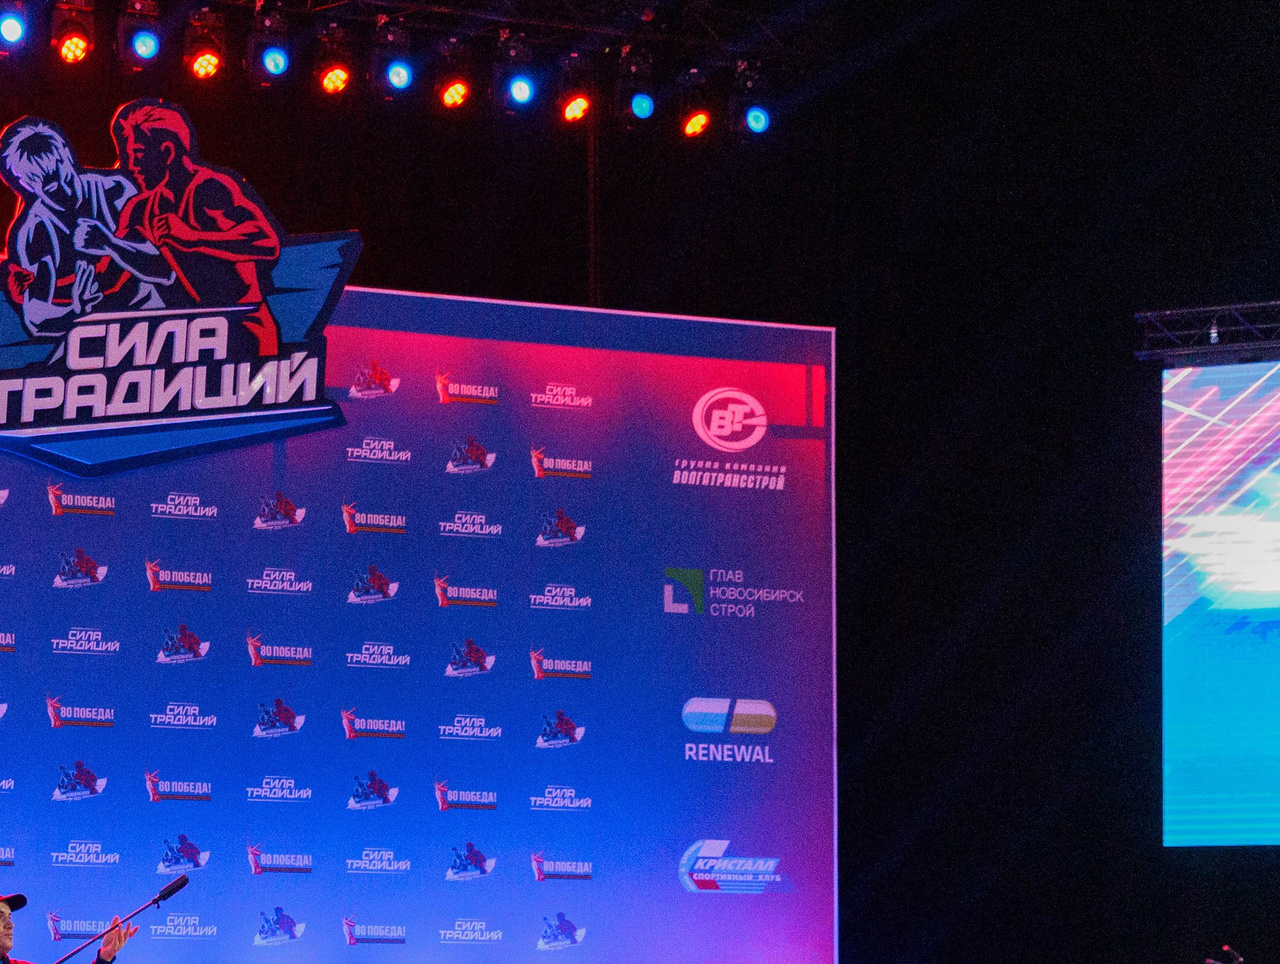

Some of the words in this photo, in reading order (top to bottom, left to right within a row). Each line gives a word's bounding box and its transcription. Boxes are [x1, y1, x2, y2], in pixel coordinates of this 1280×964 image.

[67, 316, 229, 370] СИЛА
[448, 383, 459, 393] 80
[460, 384, 498, 398] ПОБЕДА!
[546, 386, 576, 396] СИЛА
[530, 394, 592, 407] ТРАДИЦИЙ
[362, 440, 394, 450] СИЛА
[346, 448, 411, 461] ТРАДИЦИЙ
[543, 458, 554, 468] 80
[555, 459, 592, 471] ПОБЕДА!
[675, 459, 719, 469] группа
[673, 470, 785, 490] ВОЛГАТРАНССТРОЙ
[61, 494, 73, 505] 80
[74, 495, 115, 508] ПОБЕДА!
[167, 495, 200, 506] СИЛА
[151, 503, 217, 517] ТРАДИЦИЙ
[355, 513, 366, 523] 80
[368, 514, 406, 527] ПОБЕДА!
[454, 515, 485, 524] СИЛА
[439, 523, 502, 535] ТРАДИЦИЙ
[159, 571, 170, 581] 80
[171, 571, 212, 584] ПОБЕДА!
[263, 572, 295, 581] СИЛА
[709, 569, 744, 582] ГЛАВ
[246, 580, 312, 591] ТРАДИЦИЙ
[447, 586, 458, 597] 80
[460, 587, 497, 600] ПОБЕДА!
[544, 587, 575, 597] СИЛА
[709, 586, 804, 603] НОВОСИБИРСК
[529, 595, 592, 607] ТРАДИЦИЙ
[710, 603, 755, 618] СТРОЙ
[68, 631, 101, 640] СИЛА
[51, 639, 119, 652] ТРАДИЦИЙ
[362, 646, 393, 655] СИЛА
[260, 646, 271, 656] 80
[273, 647, 312, 658] ПОБЕДА!
[346, 654, 410, 665] ТРАДИЦИЙ
[543, 659, 553, 669] 80
[554, 660, 592, 672] ПОБЕДА!
[61, 707, 72, 718] 80
[73, 708, 114, 720] ПОБЕДА!
[166, 706, 199, 715] СИЛА
[150, 714, 217, 726] ТРАДИЦИЙ
[355, 719, 366, 729] 80
[367, 719, 405, 731] ПОБЕДА!
[454, 718, 485, 727] СИЛА
[438, 726, 502, 738] ТРАДИЦИЙ
[684, 743, 774, 764] RENEWAL
[158, 781, 170, 791] 80
[171, 782, 211, 793] ПОБЕДА!
[262, 779, 294, 788] СИЛА
[246, 787, 312, 799] ТРАДИЦИЙ
[447, 791, 458, 801] 80
[460, 792, 497, 803] ПОБЕДА!
[545, 789, 575, 798] СИЛА
[530, 797, 592, 808] ТРАДИЦИЙ
[68, 843, 101, 852] СИЛА
[51, 852, 119, 863] ТРАДИЦИЙ
[260, 854, 271, 865] 80
[273, 855, 312, 866] ПОБЕДА!
[362, 851, 393, 860] СИЛА
[346, 860, 410, 870] ТРАДИЦИЙ
[543, 862, 554, 871] 80
[555, 862, 592, 873] ПОБЕДА!
[693, 858, 776, 871] КРИСТАЛЛ
[60, 920, 72, 931] 80
[166, 917, 198, 926] СИЛА
[454, 922, 485, 930] СИЛА
[150, 926, 217, 936] ТРАДИЦИЙ
[355, 925, 366, 935] 80
[368, 925, 406, 937] ПОБЕДА!
[439, 930, 502, 941] ТРАДИЦИЙ
